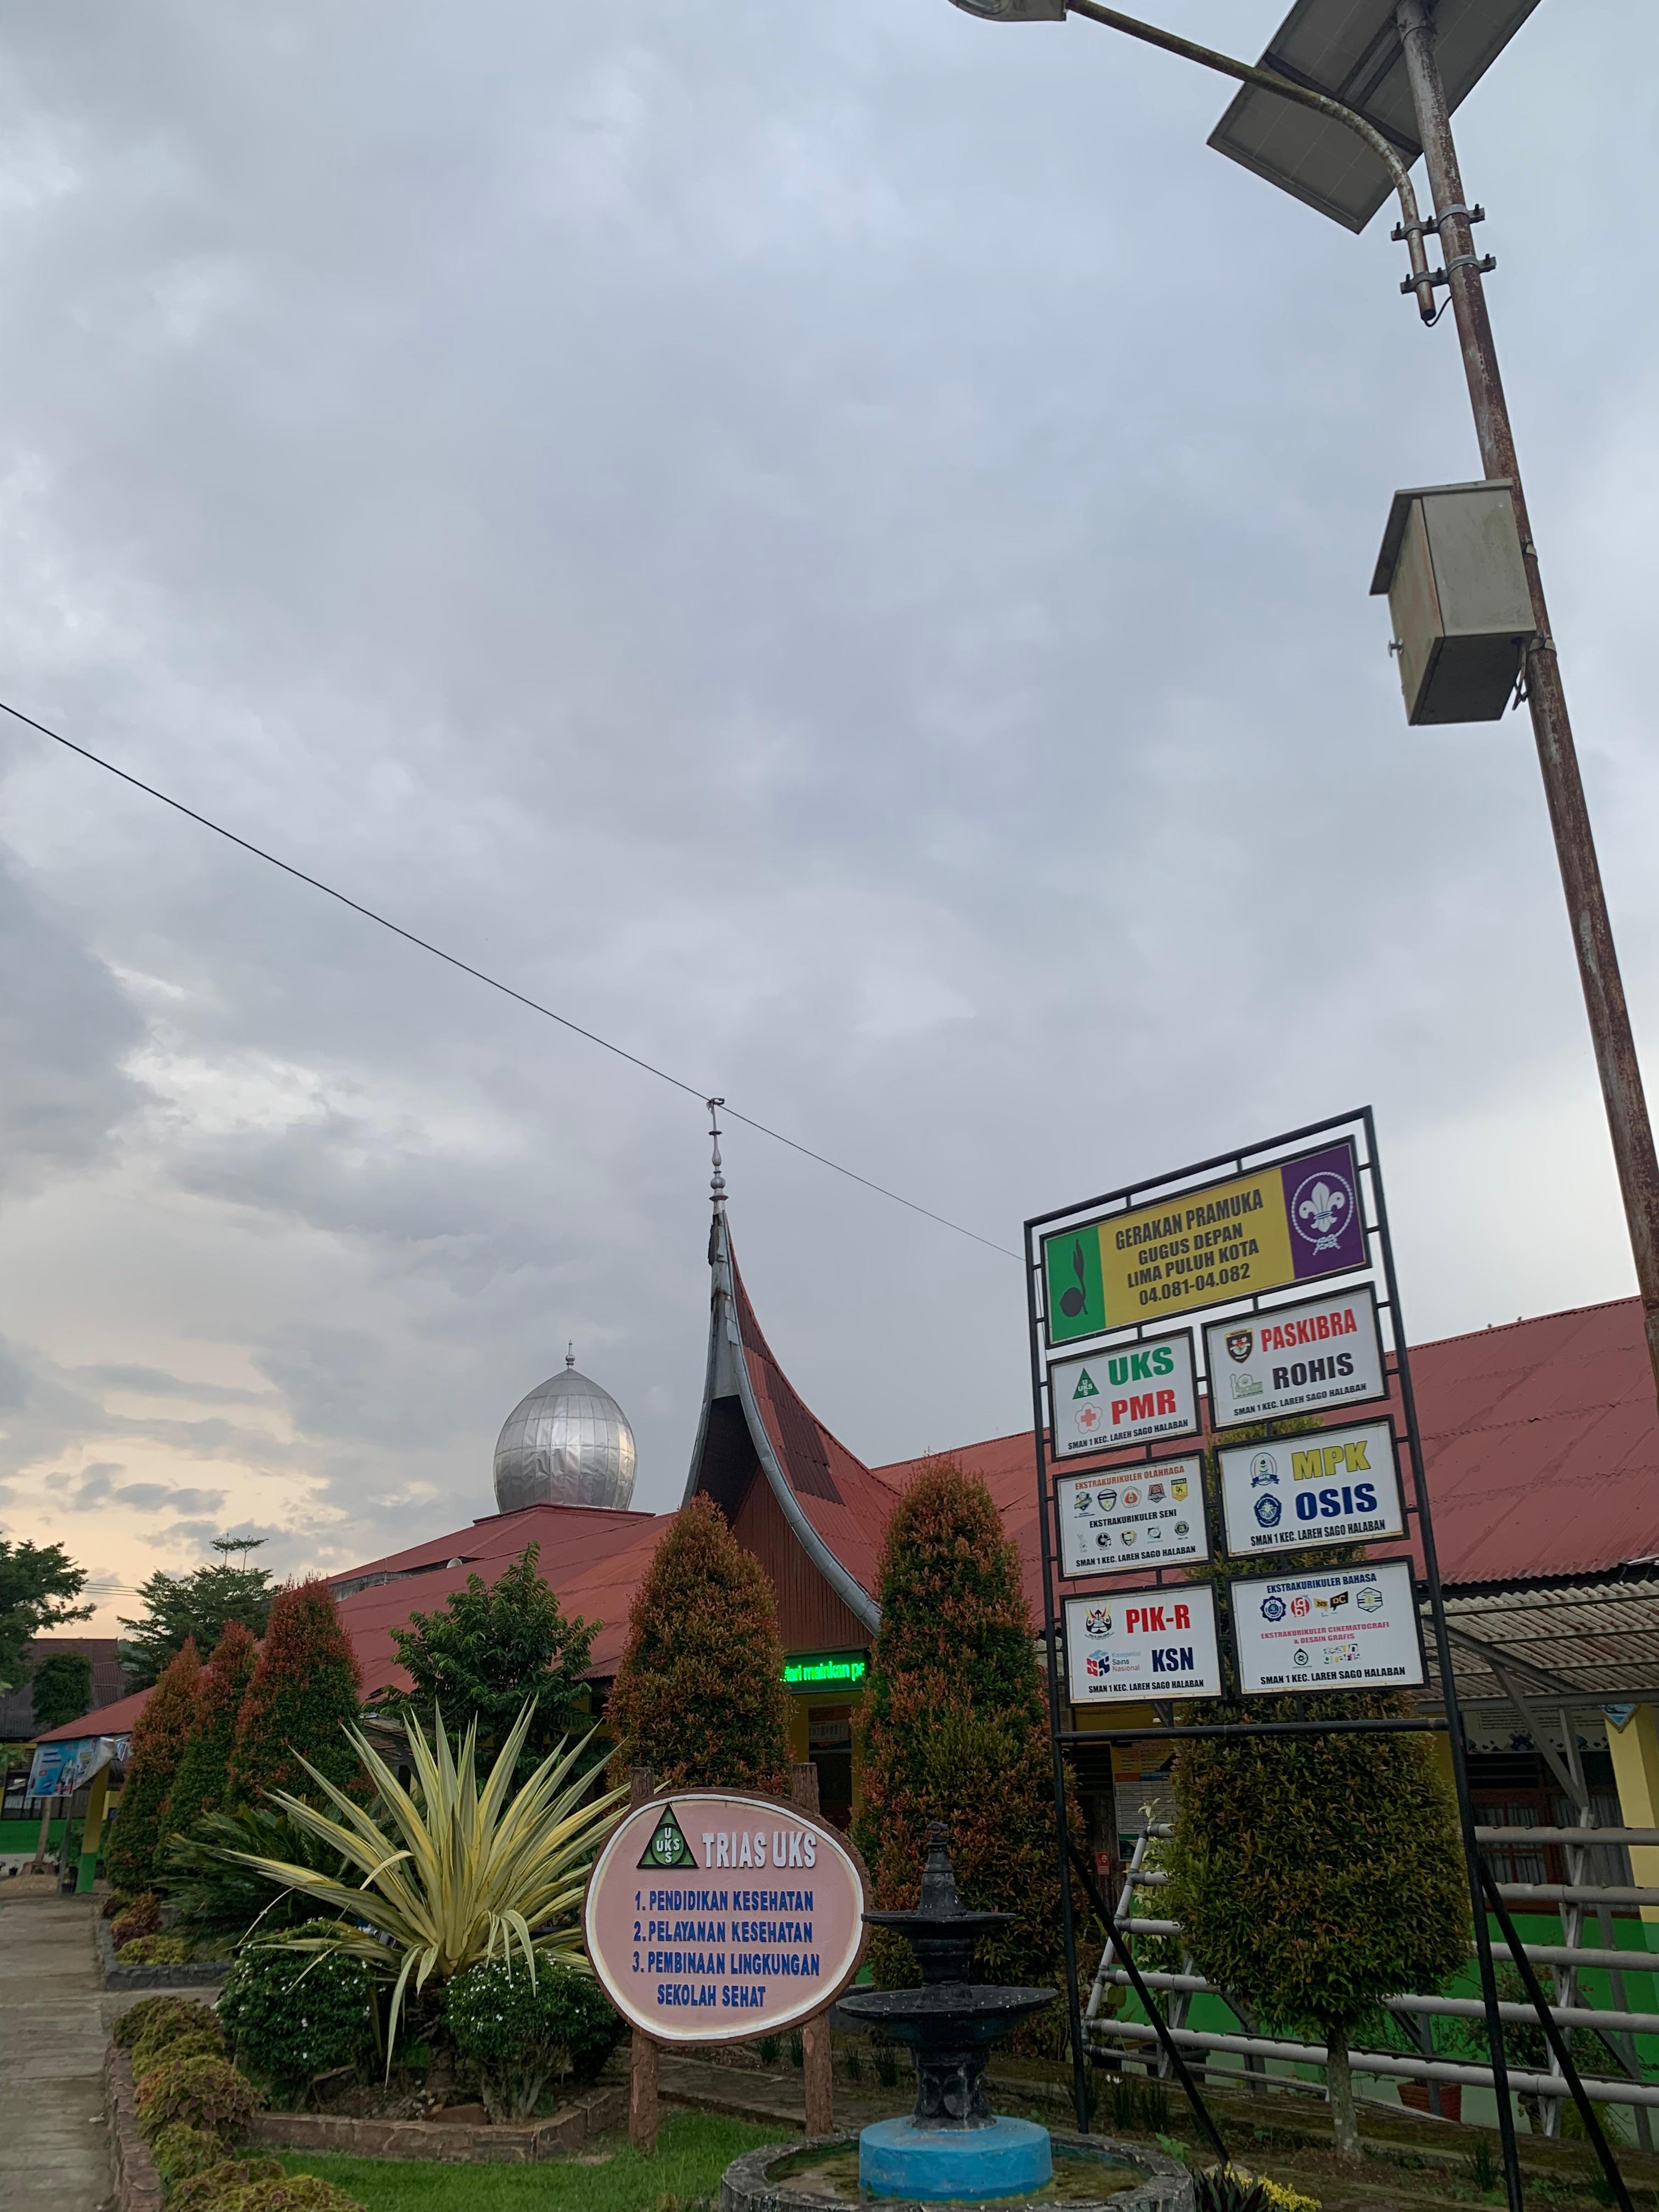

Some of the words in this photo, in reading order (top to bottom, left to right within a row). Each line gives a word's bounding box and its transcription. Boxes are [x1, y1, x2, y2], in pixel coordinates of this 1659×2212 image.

[1115, 1212, 1183, 1250] GERAKAN
[1186, 1188, 1263, 1231] PRAMUKA
[1138, 1238, 1190, 1265] GUGUS
[1194, 1222, 1243, 1250] DEPAN
[1127, 1261, 1163, 1288] LIMA
[1166, 1246, 1215, 1278] PULUH
[1218, 1238, 1260, 1269] KOTA
[1139, 1263, 1250, 1306] 04.081-04.082
[1260, 1308, 1357, 1352] PASKIBRA
[1108, 1347, 1174, 1385] UKS
[1272, 1352, 1353, 1390] ROHIS
[1111, 1389, 1176, 1425] PMR
[1234, 1404, 1255, 1416] SMAN
[1262, 1400, 1279, 1410] KEC.
[1280, 1396, 1304, 1407] LAREH
[1306, 1391, 1327, 1402] SAGO
[1329, 1384, 1367, 1397] HALABAN
[1068, 1439, 1087, 1450] SMAN
[1094, 1435, 1109, 1444] KEC.
[1110, 1431, 1132, 1441] LAREH
[1133, 1426, 1153, 1436] SAGO
[1154, 1419, 1188, 1432] HALABAN
[1291, 1441, 1371, 1481] MPK
[1075, 1473, 1142, 1489] EKSTRAKURIKULER
[1144, 1466, 1184, 1479] OLAHRAGA
[1295, 1483, 1377, 1521] OSIS
[1090, 1512, 1158, 1528] EKSTRAKURIKULER
[1159, 1509, 1177, 1519] SENI
[1250, 1534, 1273, 1547] SMAN
[1274, 1534, 1278, 1543] 1
[1279, 1531, 1296, 1543] KEC.
[1297, 1528, 1322, 1540] LAREH
[1324, 1525, 1346, 1537] SAGO
[1347, 1520, 1386, 1534] HALABAN
[1076, 1558, 1095, 1567] SMAN
[1102, 1555, 1117, 1564] KEC.
[1118, 1552, 1139, 1562] LAREH
[1141, 1549, 1161, 1559] SAGO
[1162, 1545, 1196, 1556] HALABAN
[1267, 1579, 1341, 1594] EKSTRAKURIKULER
[1343, 1573, 1377, 1585] BAHASA
[1126, 1604, 1190, 1633] PIK-R
[1261, 1627, 1327, 1639] EKSTRAKURIKULER
[1328, 1621, 1390, 1633] CINEMATOGRAFI
[1300, 1635, 1326, 1644] DESAIN
[1328, 1633, 1355, 1641] GRAFIS
[1152, 1647, 1194, 1672] KSN
[1088, 1685, 1108, 1694] SMAN
[1130, 1682, 1150, 1690] LAREH
[1152, 1681, 1170, 1690] SAGO
[1172, 1679, 1204, 1689] HALABAN
[1260, 1675, 1284, 1685] SMAN
[1291, 1674, 1310, 1683] KEC.
[1311, 1672, 1336, 1681] LAREH
[1339, 1669, 1362, 1679] SAGO
[1364, 1667, 1406, 1677] HALABAN
[702, 1832, 767, 1869] TRIAS
[772, 1831, 817, 1869] UKS
[635, 1891, 646, 1911] 1.
[650, 1891, 727, 1911] PENDIDIKAN
[733, 1891, 814, 1911] KESEHATAN
[633, 1922, 646, 1942] 2.
[648, 1921, 726, 1942] PELAYANAN
[732, 1922, 812, 1943] KESEHATAN
[632, 1951, 645, 1973] 3.
[647, 1951, 725, 1974] PEMBINAAN
[730, 1954, 820, 1976] LINGKUNGAN
[657, 1984, 716, 2007] SEKOLAH
[722, 1985, 766, 2007] SEHAT
